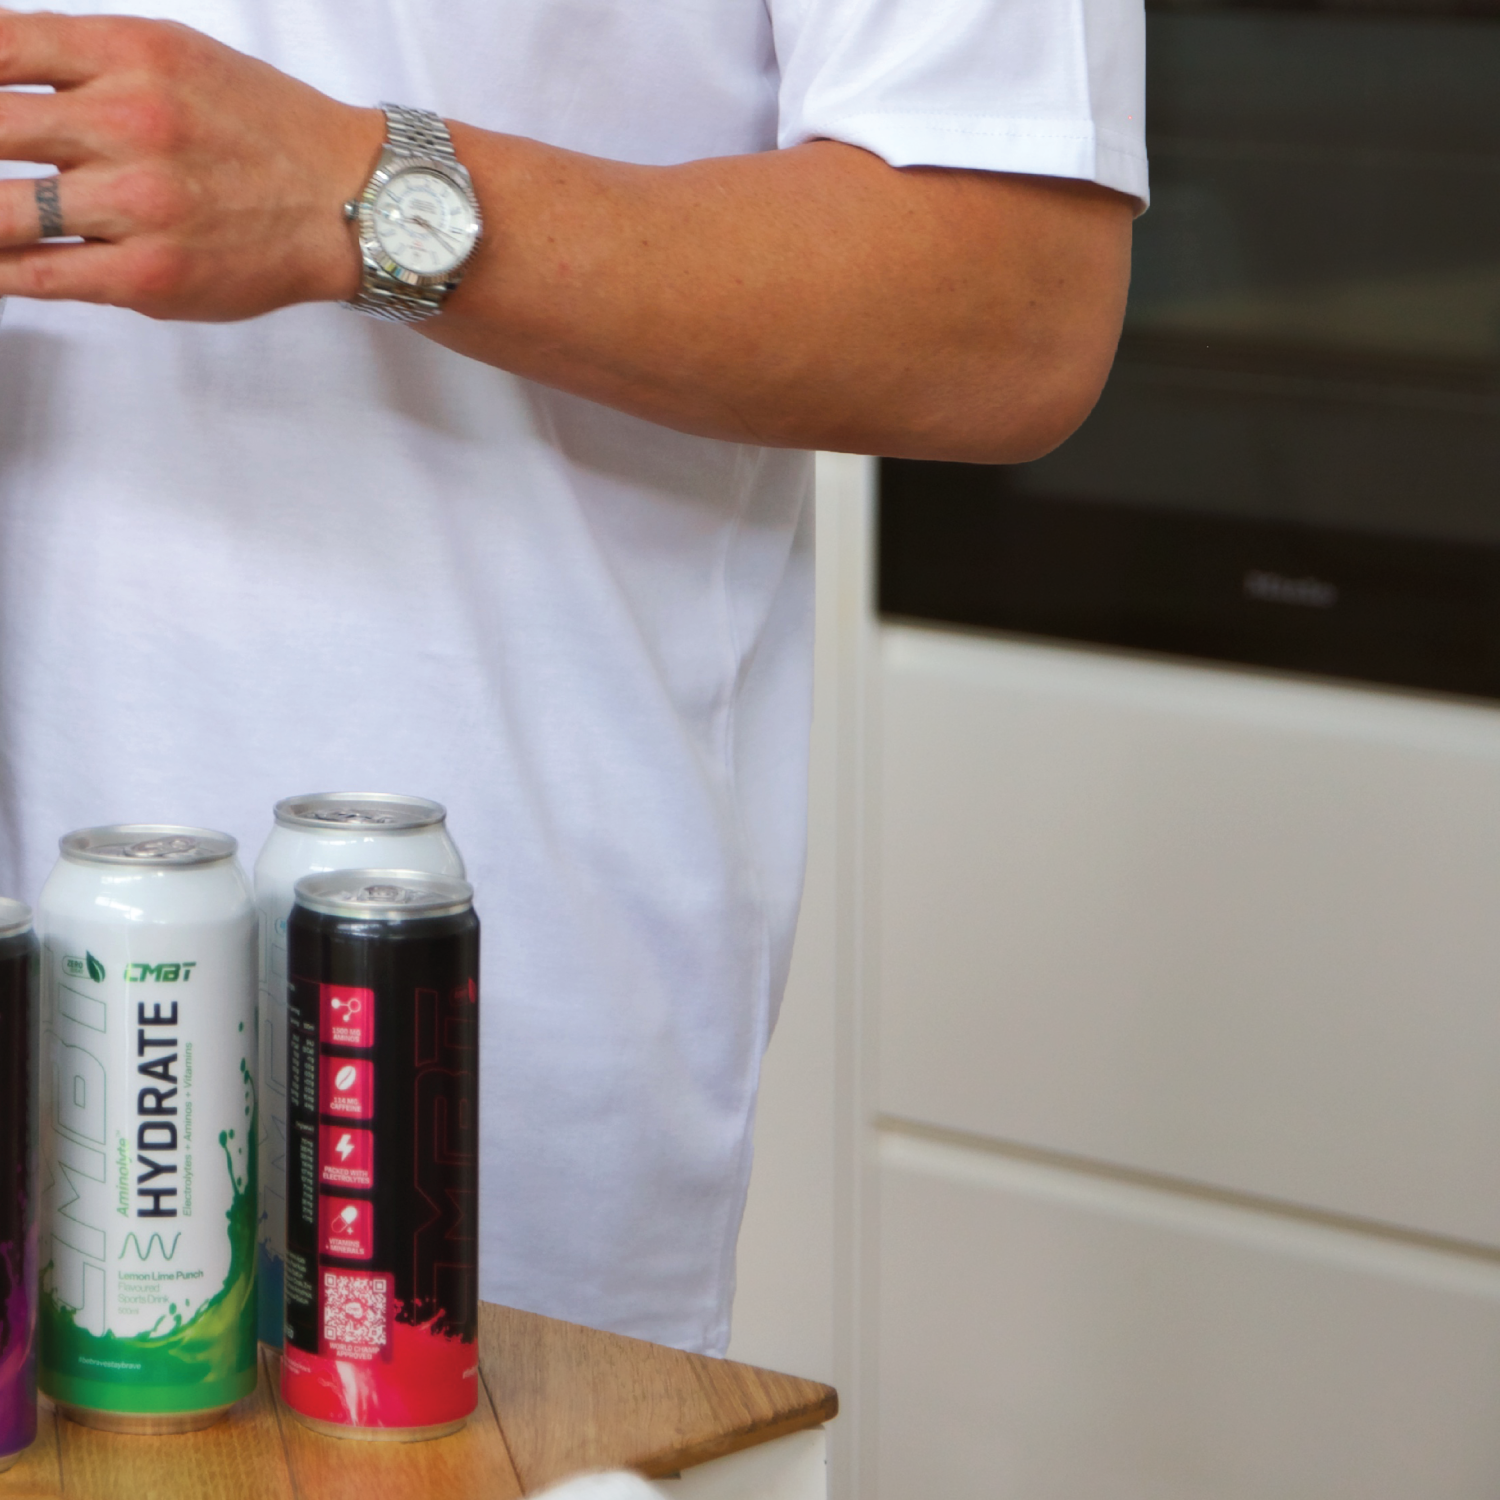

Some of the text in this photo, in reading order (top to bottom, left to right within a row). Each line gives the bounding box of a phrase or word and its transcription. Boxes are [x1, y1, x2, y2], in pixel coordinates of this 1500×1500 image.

[123, 961, 197, 982] CMBT
[182, 1041, 193, 1089] Vitamins
[137, 1001, 178, 1218] HYDRATE
[329, 1102, 361, 1113] CAFFEINE
[183, 1101, 193, 1142] Aminos
[324, 1165, 368, 1178] PACKED WITH
[322, 1172, 370, 1185] ELECTROLYTES
[182, 1154, 194, 1218] Electrolytes
[329, 1238, 360, 1249] VITAMINS
[330, 1244, 365, 1255] MINERALS
[118, 1269, 204, 1281] Lemon Lime Punch
[118, 1282, 160, 1292] Flavoured
[118, 1293, 169, 1304] Sports Drink
